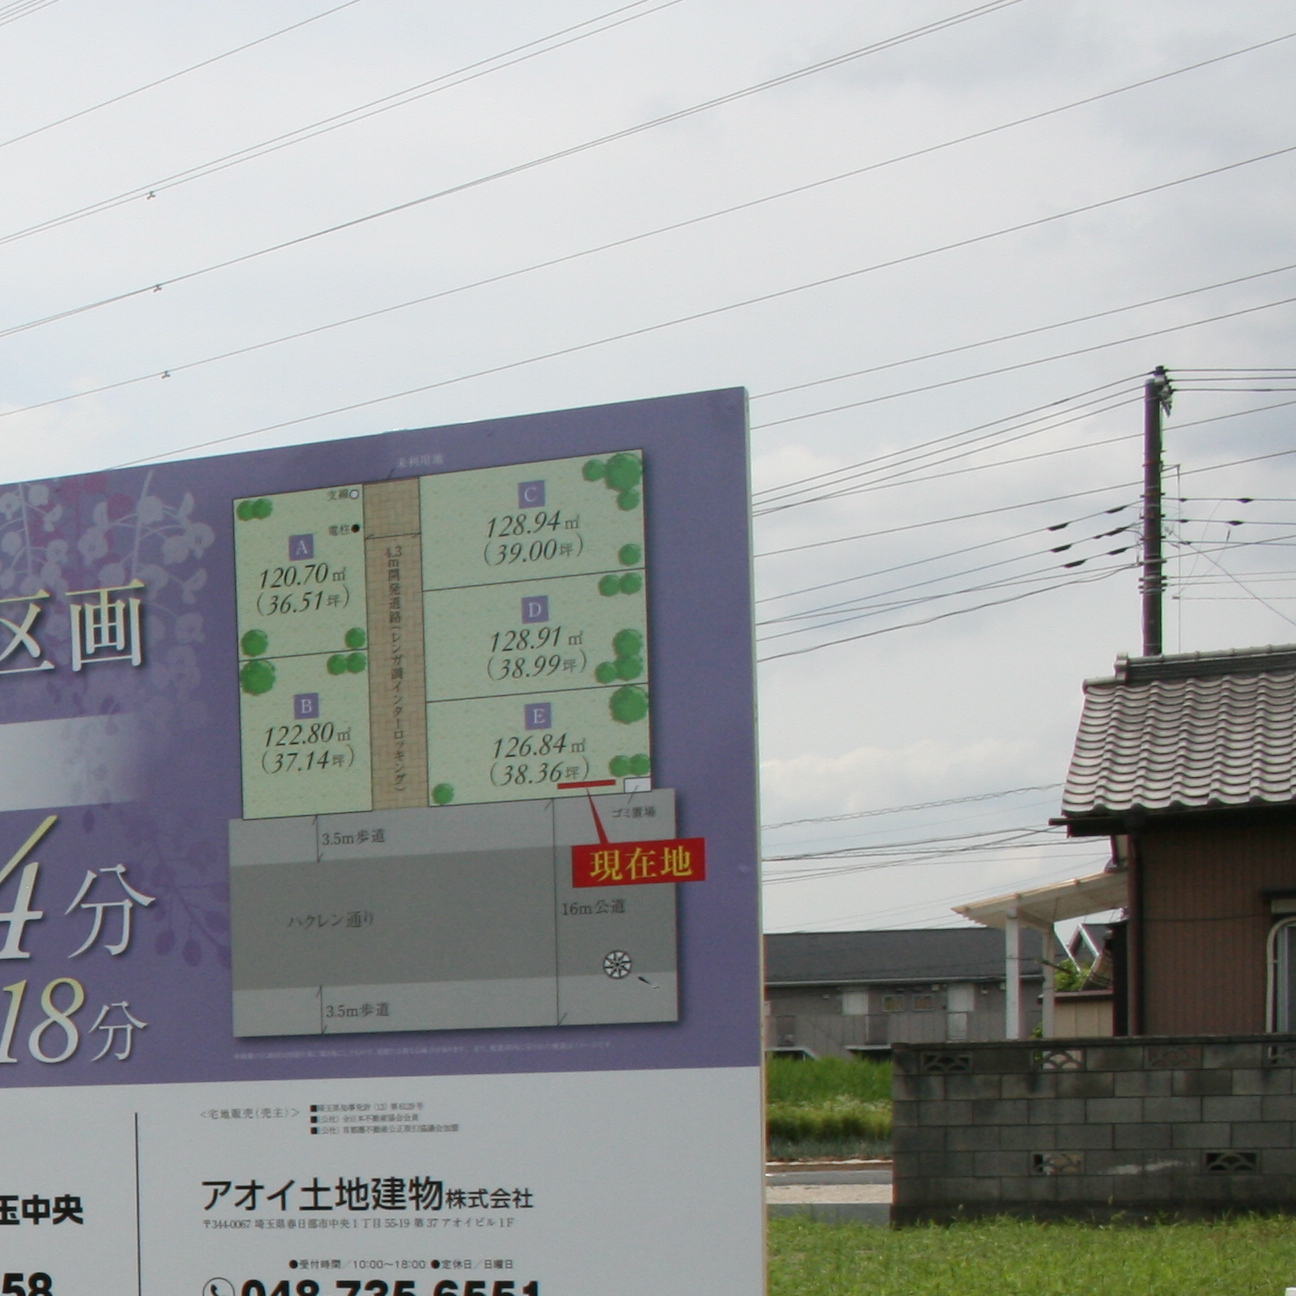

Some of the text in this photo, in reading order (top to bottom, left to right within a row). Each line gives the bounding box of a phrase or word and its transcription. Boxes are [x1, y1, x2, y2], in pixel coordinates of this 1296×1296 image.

[322, 829, 385, 846] 3.5m歩道
[589, 846, 693, 882] 現在地
[562, 899, 625, 916] 16m公道
[287, 910, 374, 930] ハクレン通り
[326, 1003, 389, 1018] 3.5m歩道
[201, 1176, 534, 1211] アオイ土地建物株式会社
